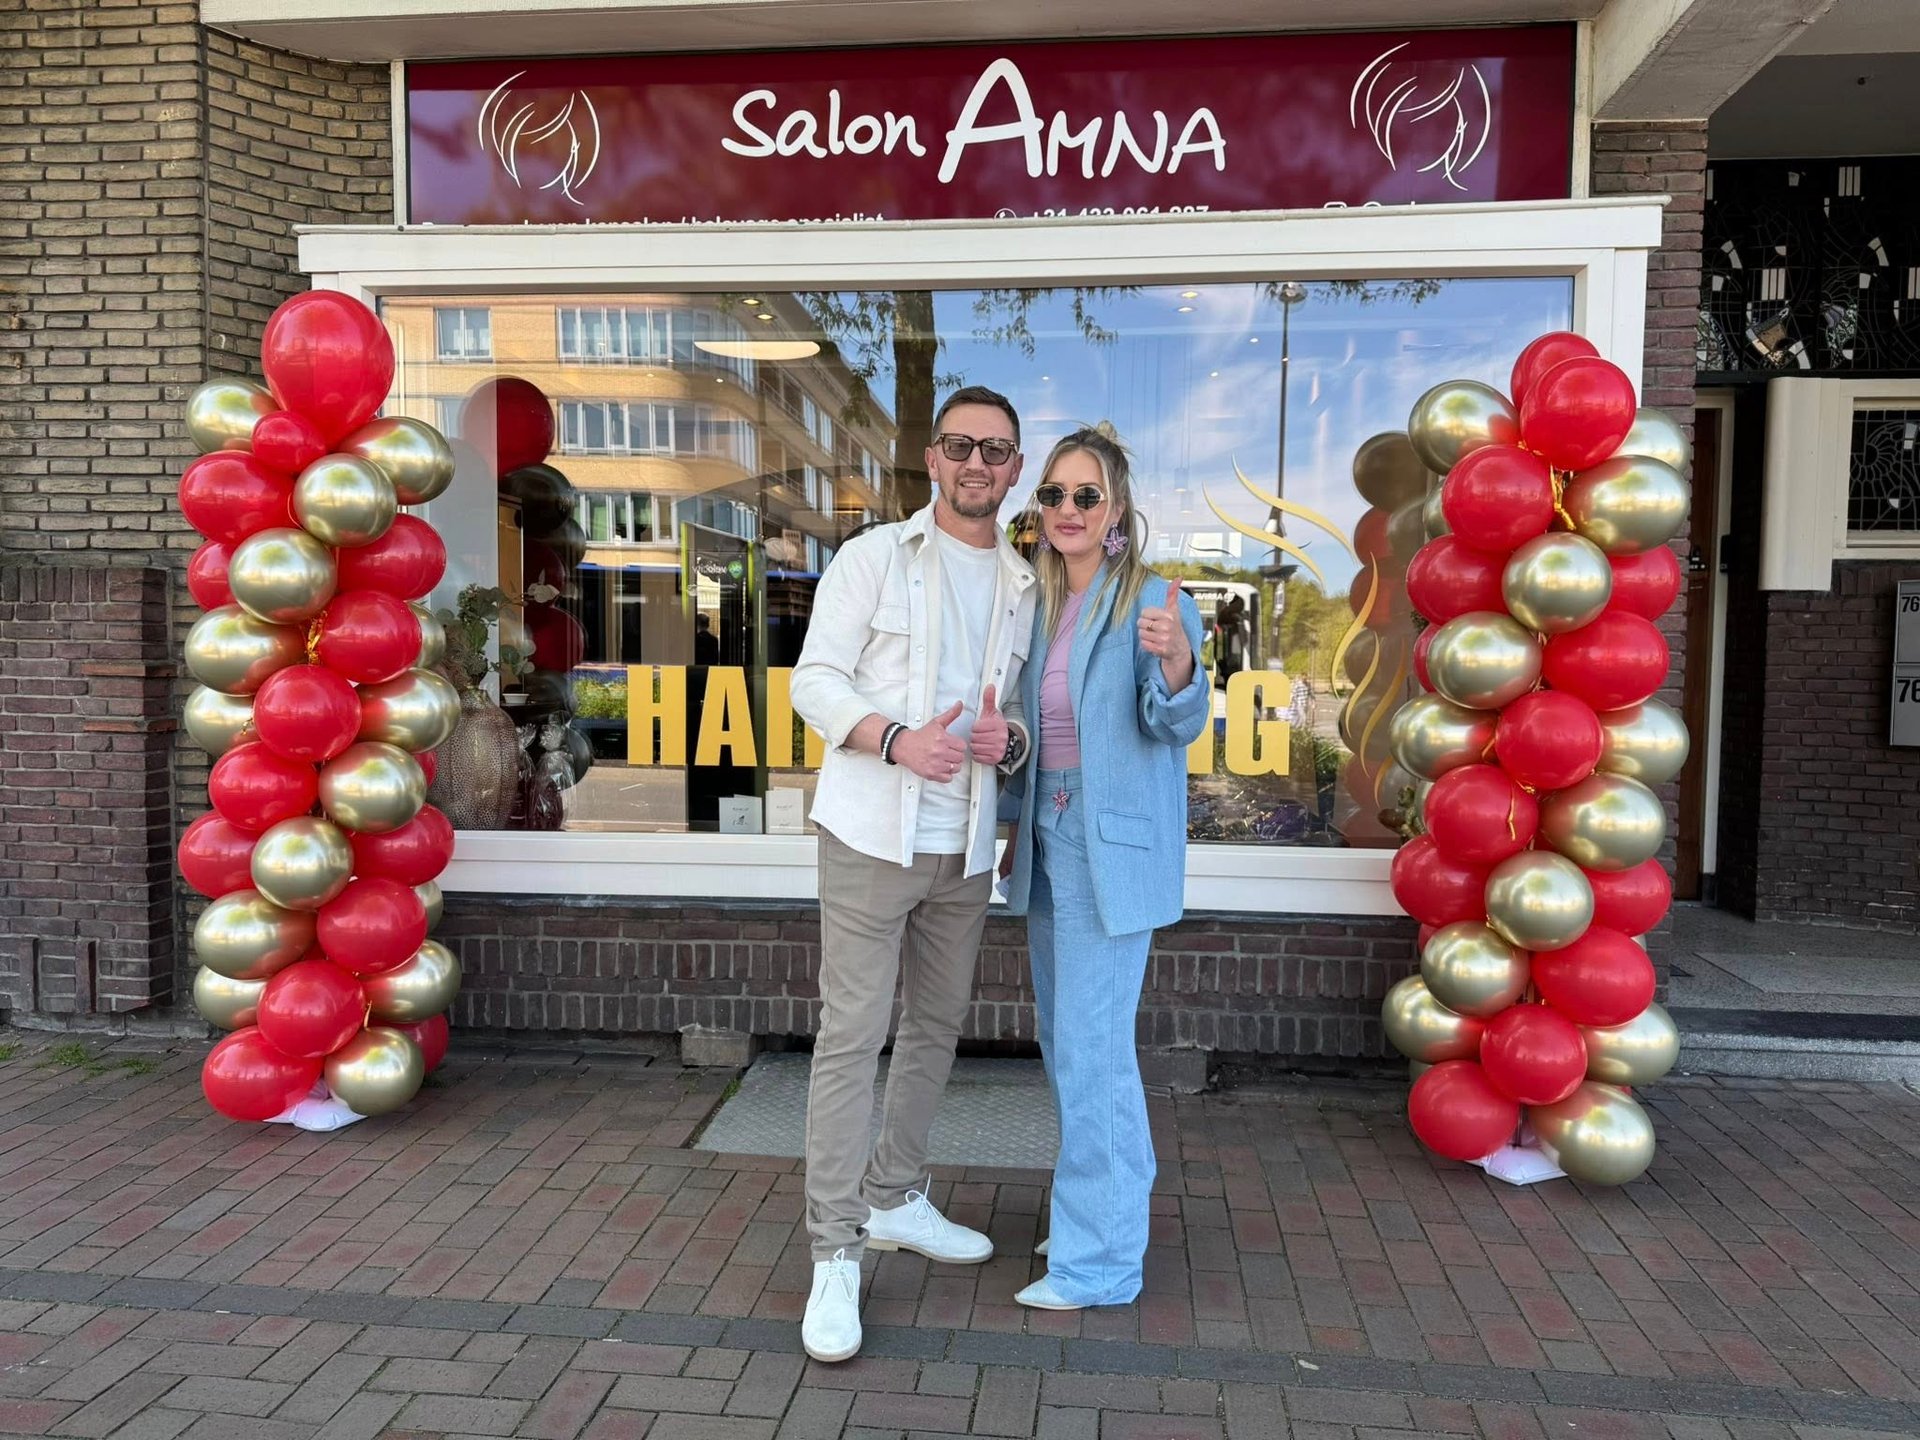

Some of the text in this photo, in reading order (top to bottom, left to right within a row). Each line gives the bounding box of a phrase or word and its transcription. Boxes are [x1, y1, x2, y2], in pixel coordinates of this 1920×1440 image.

[722, 59, 1226, 183] Salon AMNA
[1901, 596, 1920, 613] 76
